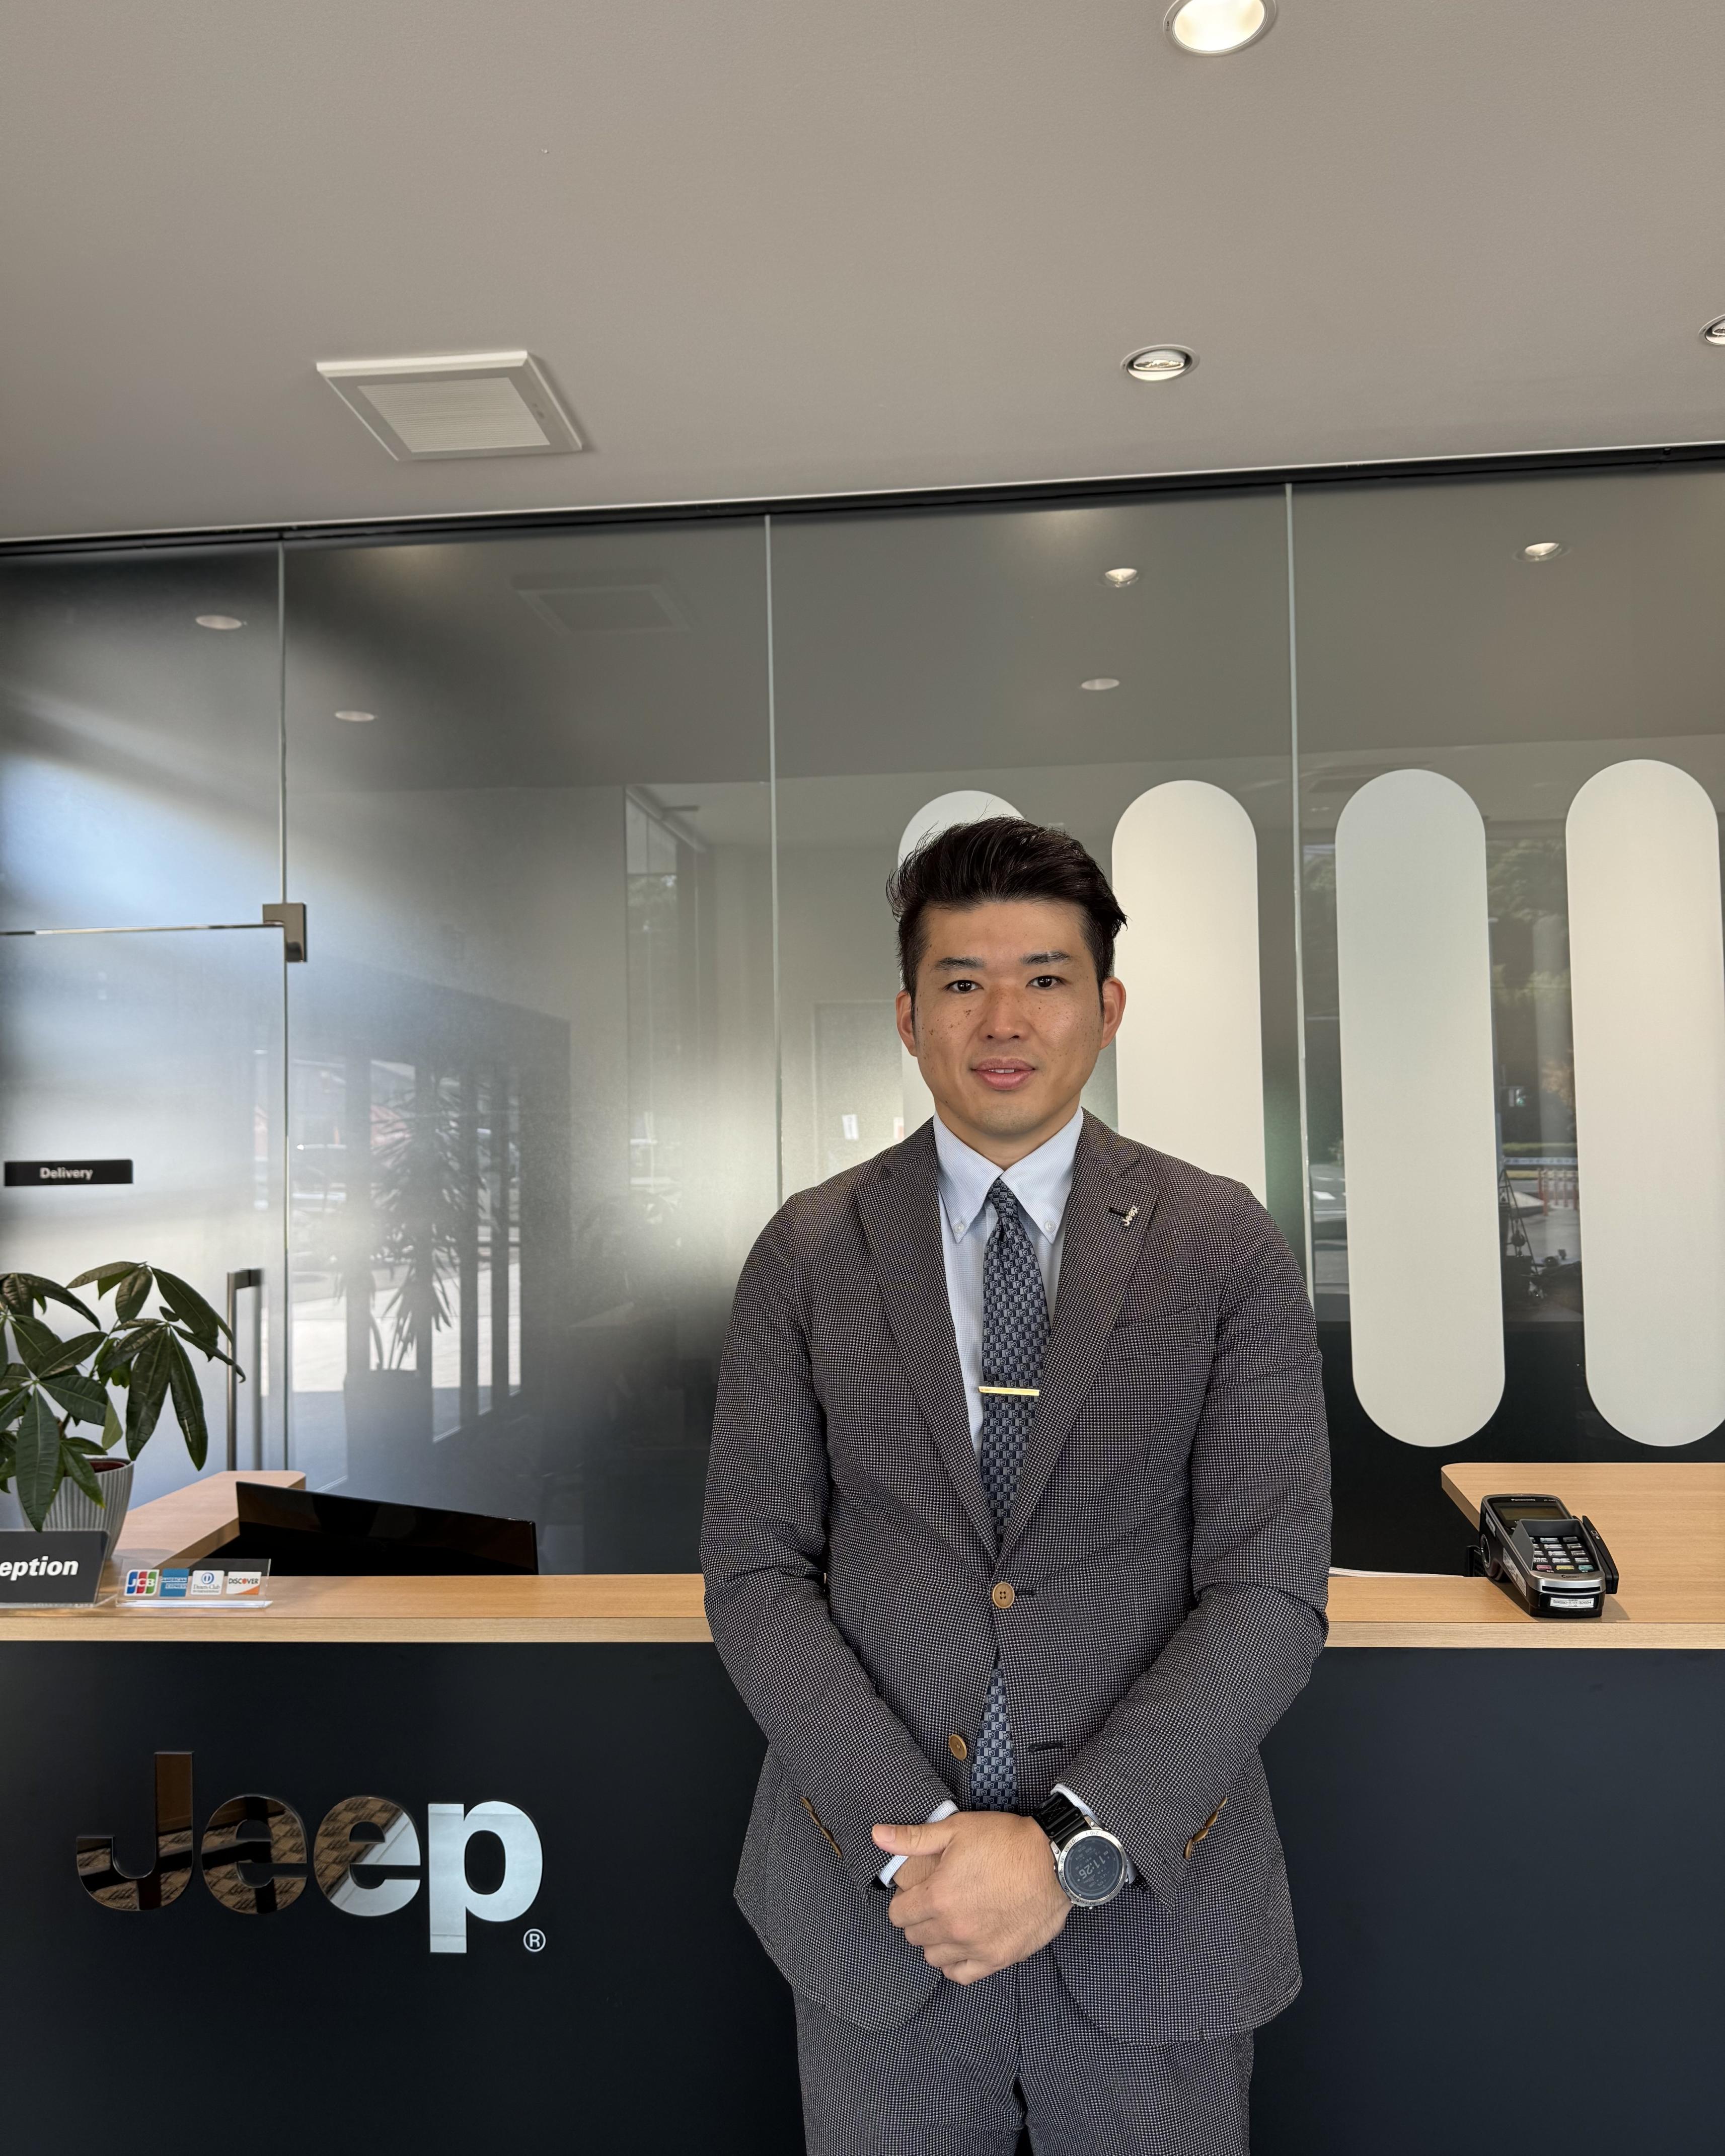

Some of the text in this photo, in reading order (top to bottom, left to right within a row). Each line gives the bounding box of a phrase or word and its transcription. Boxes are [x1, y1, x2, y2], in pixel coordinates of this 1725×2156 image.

[40, 1167, 93, 1180] Delivery
[0, 1556, 79, 1581] eption
[127, 1578, 155, 1587] JCB
[76, 1751, 543, 1953] Jeep
